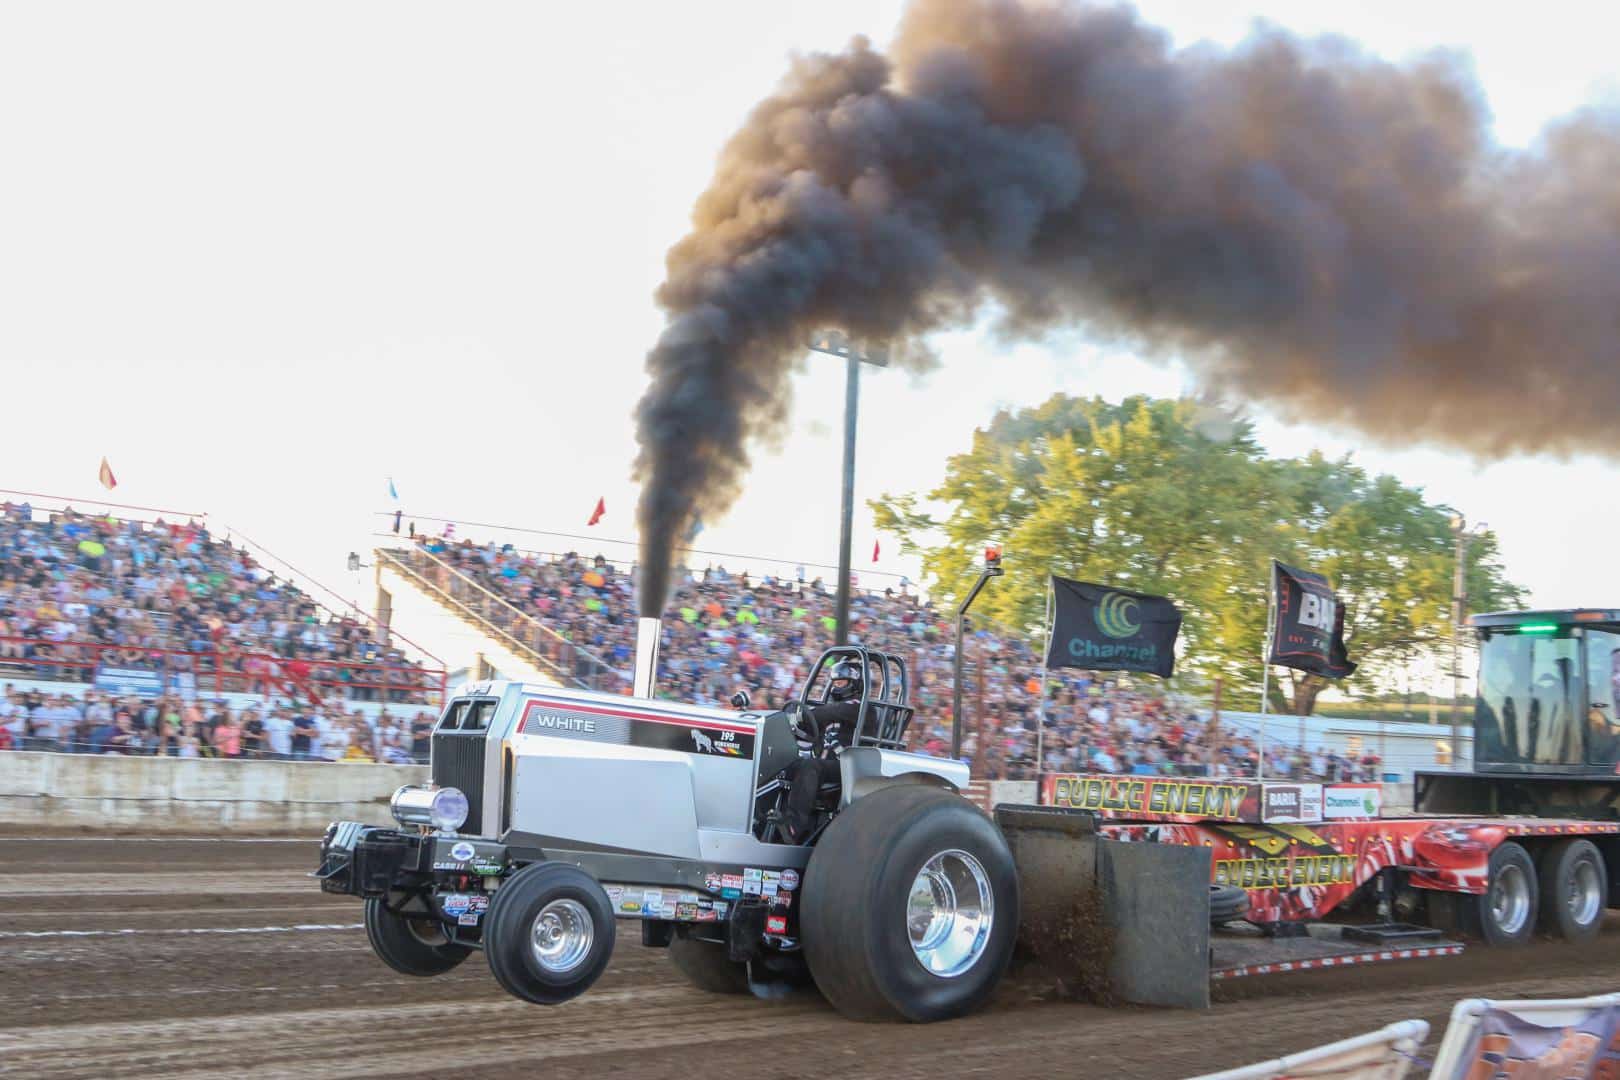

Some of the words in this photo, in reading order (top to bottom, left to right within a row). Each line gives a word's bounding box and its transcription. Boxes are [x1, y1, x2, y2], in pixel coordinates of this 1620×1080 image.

[1068, 638, 1158, 662] Channel
[538, 714, 596, 733] WHITE
[720, 731, 736, 742] 195
[1054, 777, 1145, 812] PUBLIC
[1149, 782, 1248, 818] ENEMY
[1290, 854, 1359, 887] ENEMY
